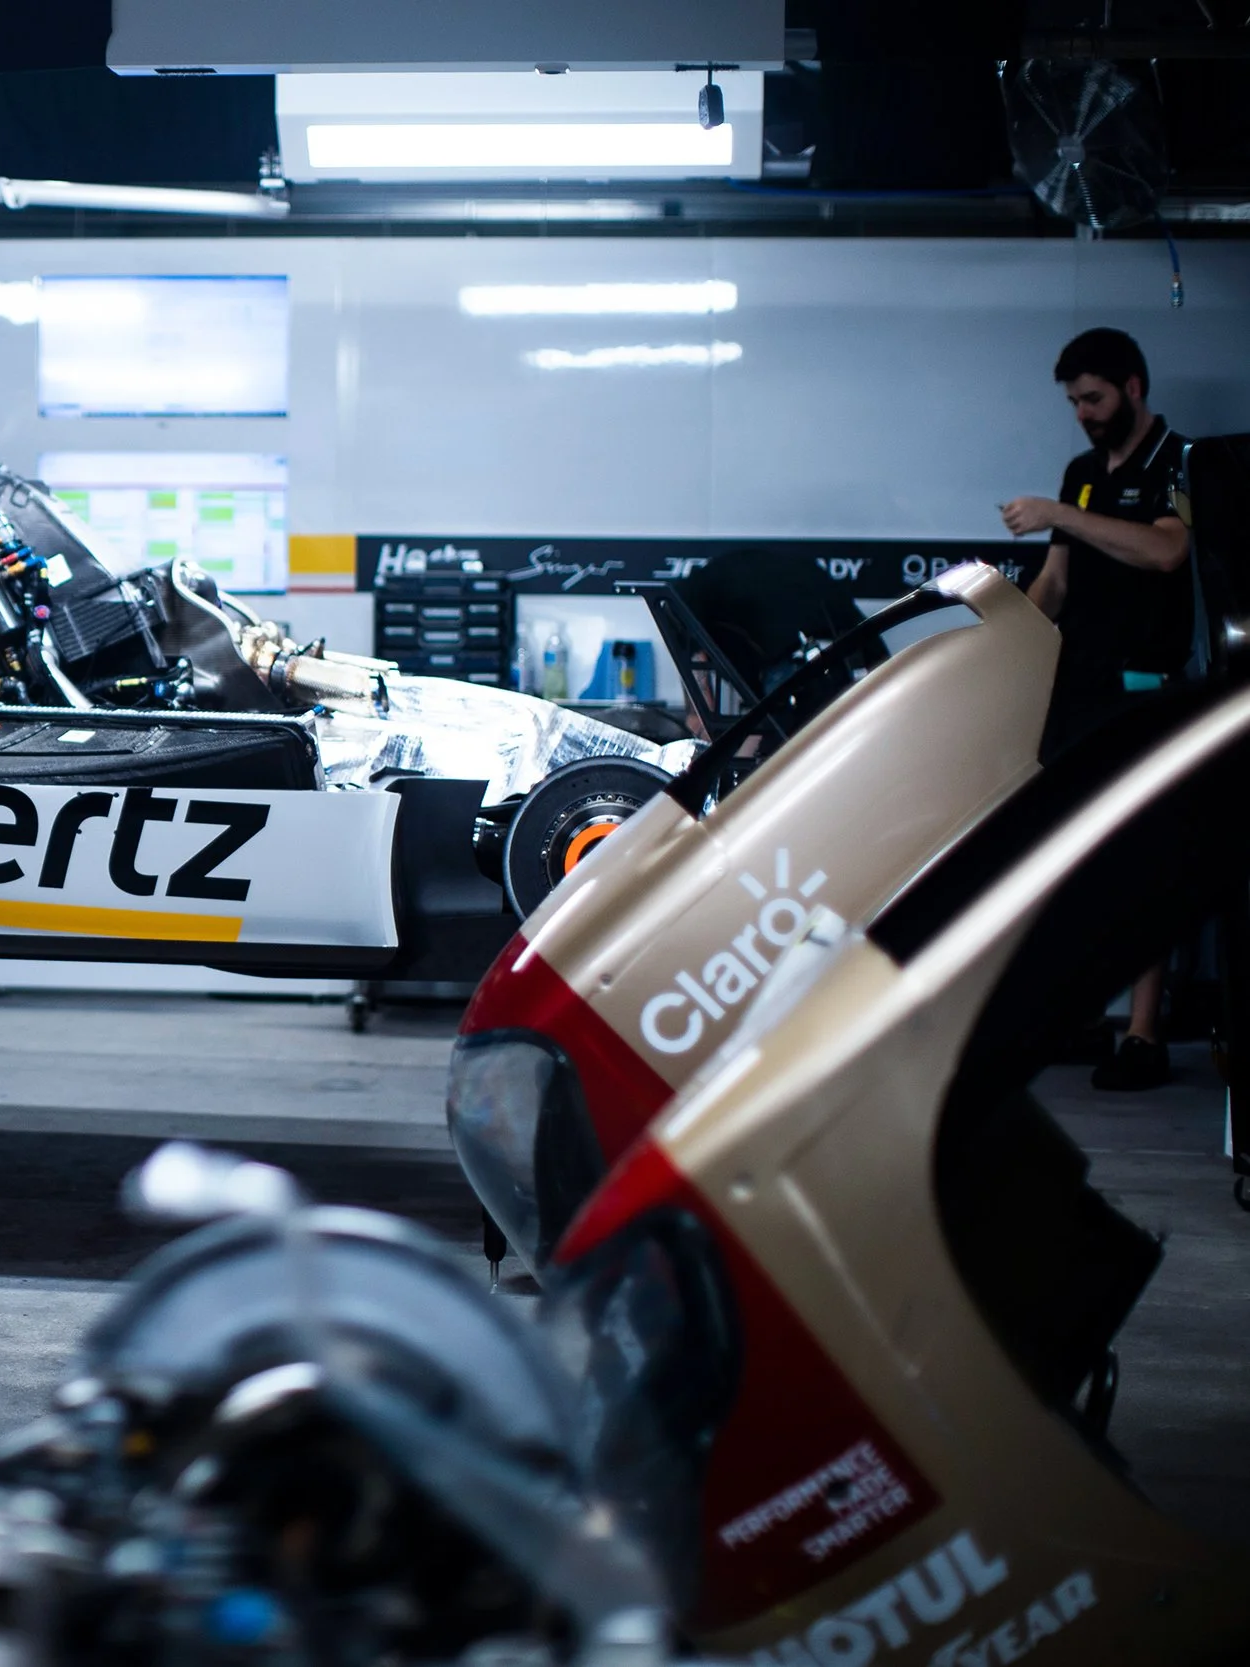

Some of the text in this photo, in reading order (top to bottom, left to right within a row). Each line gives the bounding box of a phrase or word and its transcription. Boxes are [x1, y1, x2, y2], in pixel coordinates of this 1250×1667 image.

[640, 897, 808, 1054] Claro
[718, 1438, 878, 1552] PERFORMANCE
[800, 1482, 914, 1563] SMARTER
